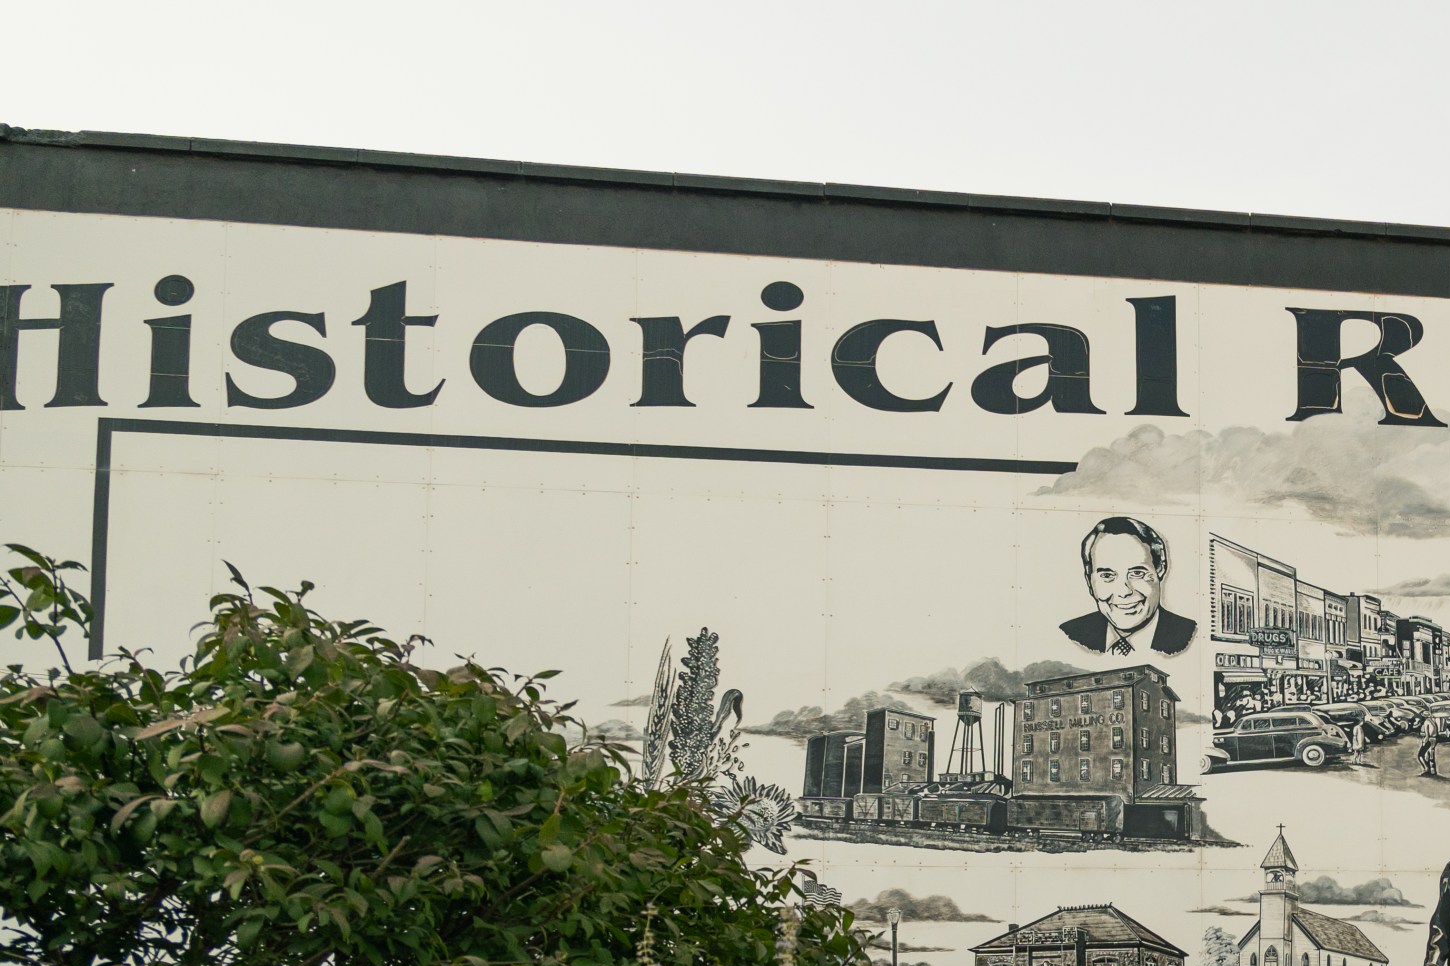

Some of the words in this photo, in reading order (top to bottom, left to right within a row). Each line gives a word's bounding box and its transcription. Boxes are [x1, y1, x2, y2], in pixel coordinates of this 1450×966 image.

[0, 275, 1190, 418] Historical
[1251, 632, 1286, 643] DRUGS
[1375, 668, 1399, 676] CAFE
[1023, 720, 1065, 733] RUSSELL
[1069, 714, 1105, 728] MILLING
